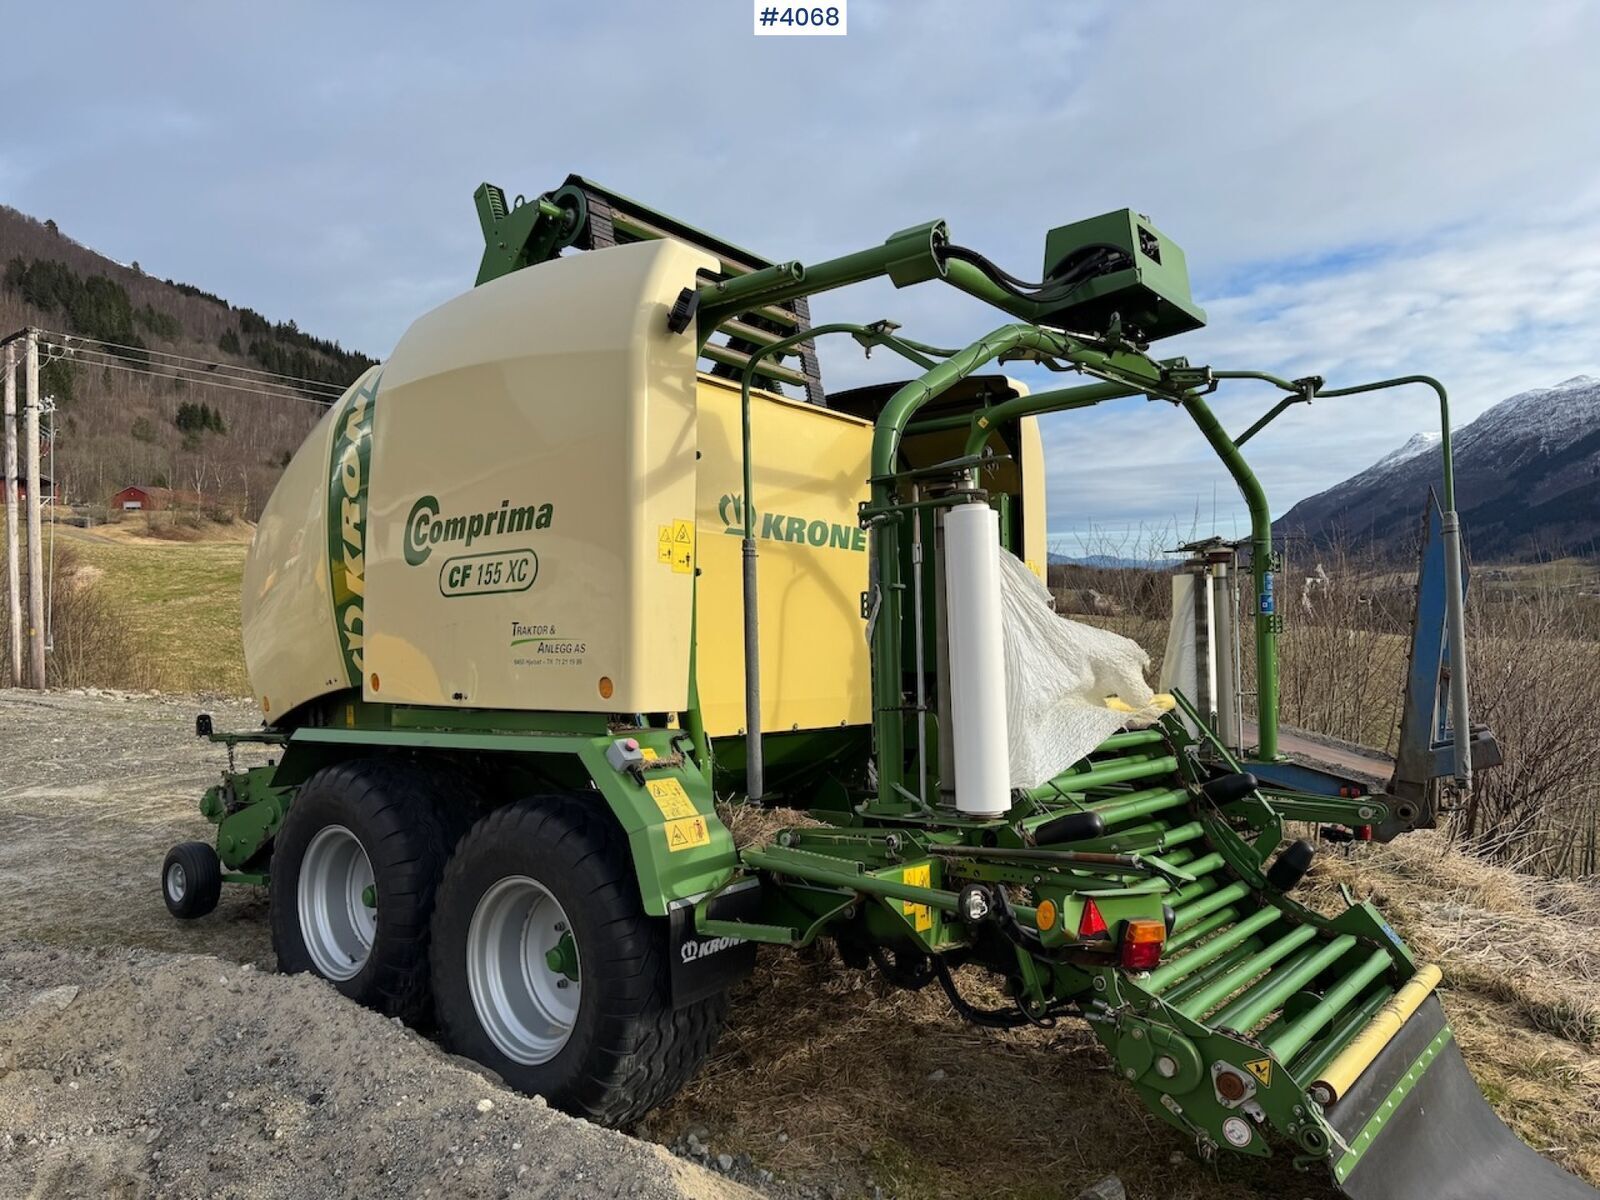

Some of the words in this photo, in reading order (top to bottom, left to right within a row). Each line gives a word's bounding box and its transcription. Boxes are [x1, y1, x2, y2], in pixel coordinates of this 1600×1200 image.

[761, 512, 867, 552] KRONE
[448, 565, 472, 588] CF
[477, 562, 503, 585] 155
[505, 558, 529, 583] XC
[574, 644, 586, 654] AS
[698, 936, 748, 958] KRON
